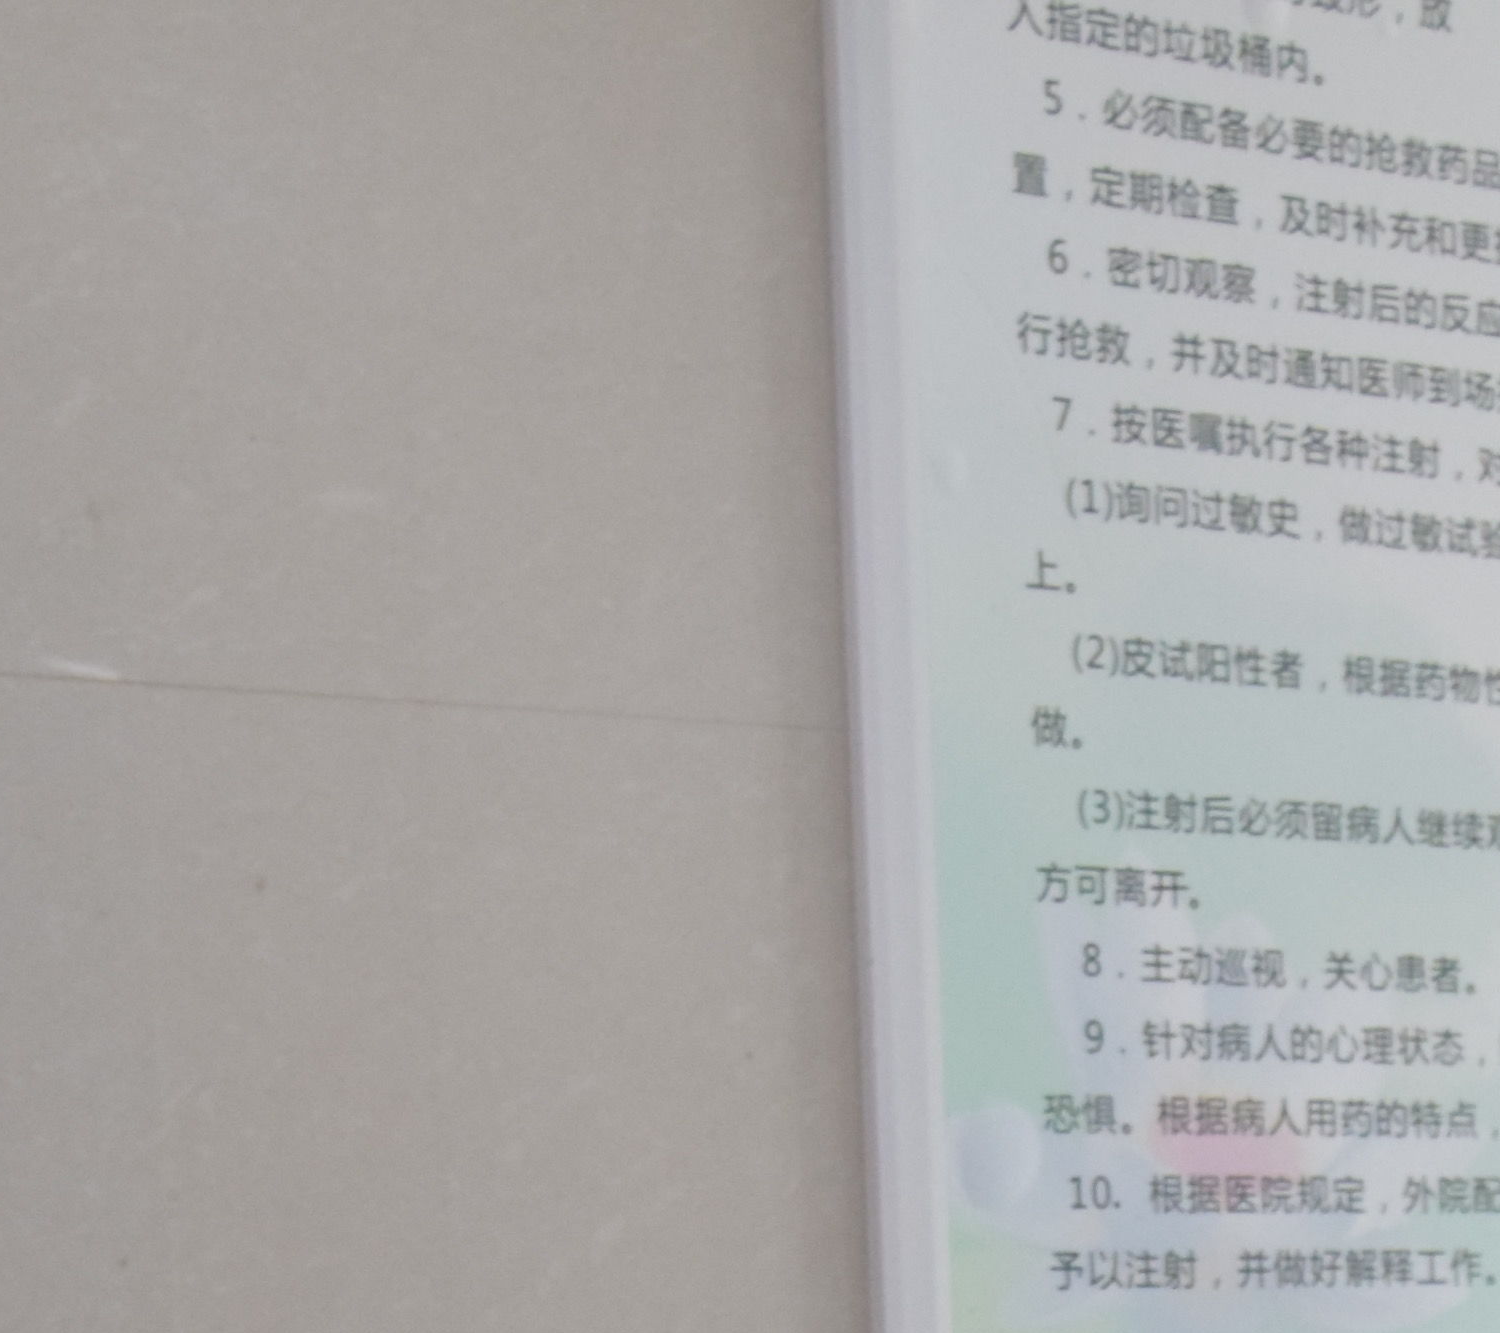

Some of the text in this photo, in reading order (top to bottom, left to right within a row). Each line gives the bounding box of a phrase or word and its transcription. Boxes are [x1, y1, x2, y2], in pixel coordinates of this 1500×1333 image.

[1025, 550, 1076, 595] 上。
[1031, 706, 1082, 750] 做。
[1036, 861, 1200, 911] 方可离开。
[1049, 1249, 1497, 1290] 予以注射，并做好解释工作。
